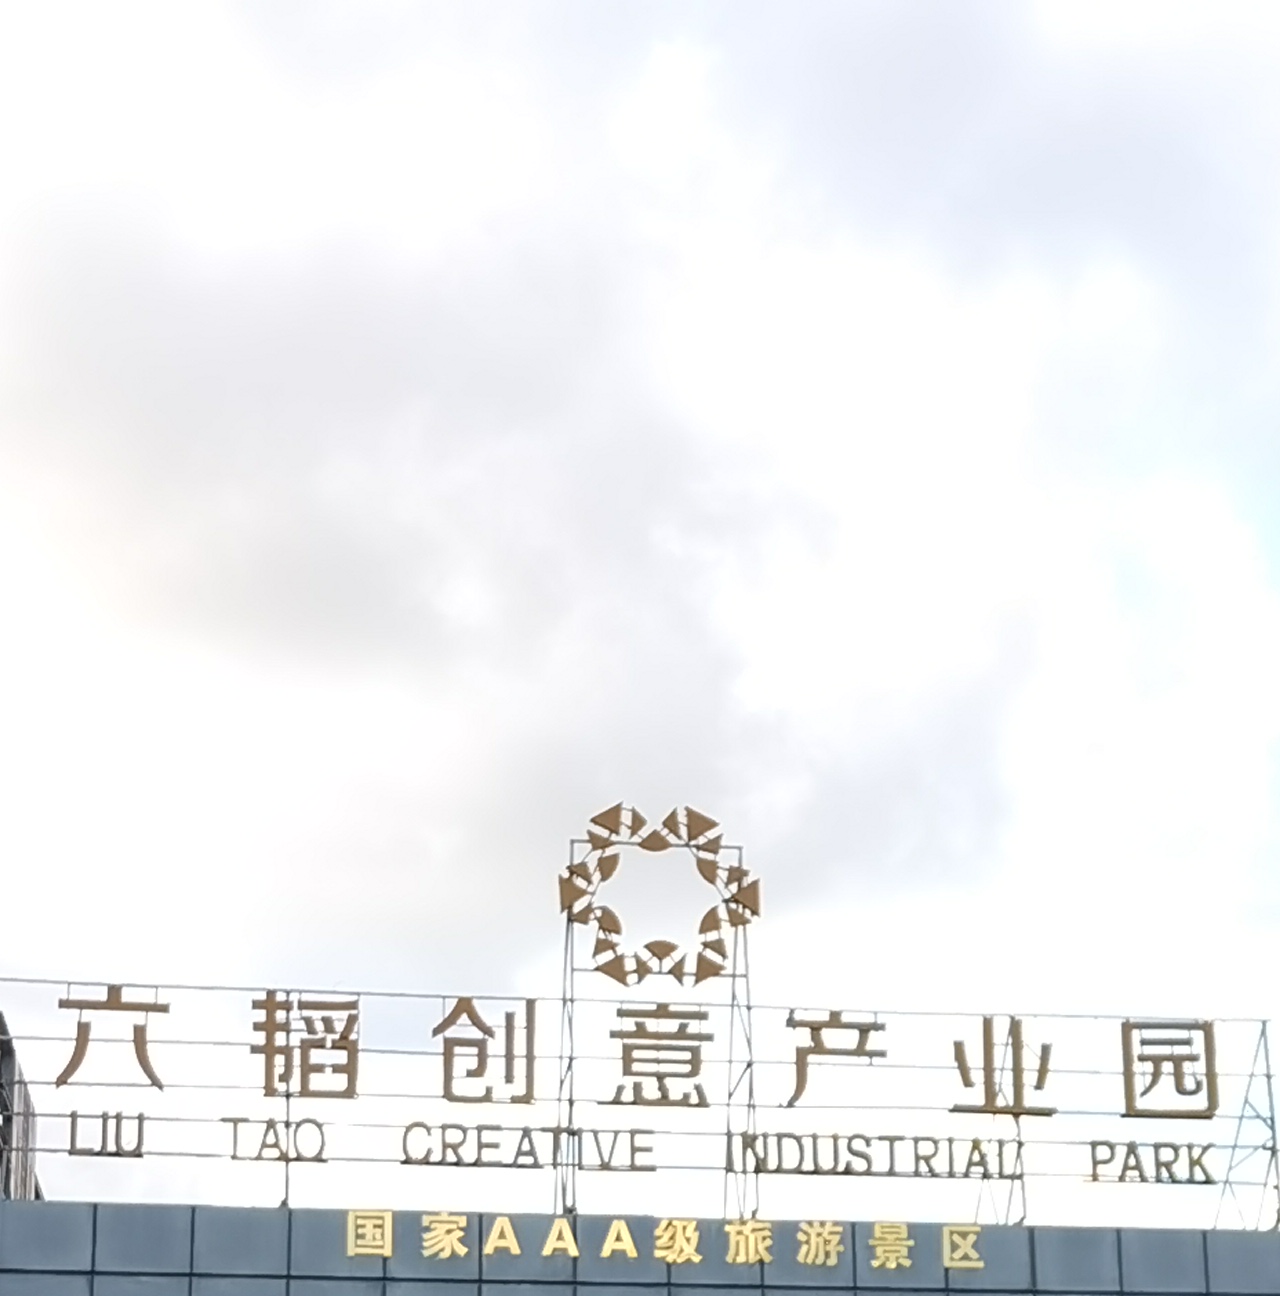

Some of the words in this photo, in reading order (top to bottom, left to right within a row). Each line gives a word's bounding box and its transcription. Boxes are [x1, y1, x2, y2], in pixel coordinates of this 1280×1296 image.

[56, 983, 1219, 1119] 六韬创意产业园
[69, 1111, 144, 1157] LIU
[222, 1118, 327, 1162] TAO
[401, 1121, 656, 1170] CREATIVE
[726, 1131, 1021, 1179] INDUSTRIAL
[1090, 1141, 1216, 1184] PARK
[346, 1209, 984, 1270] 国家AAA级旅游景区
